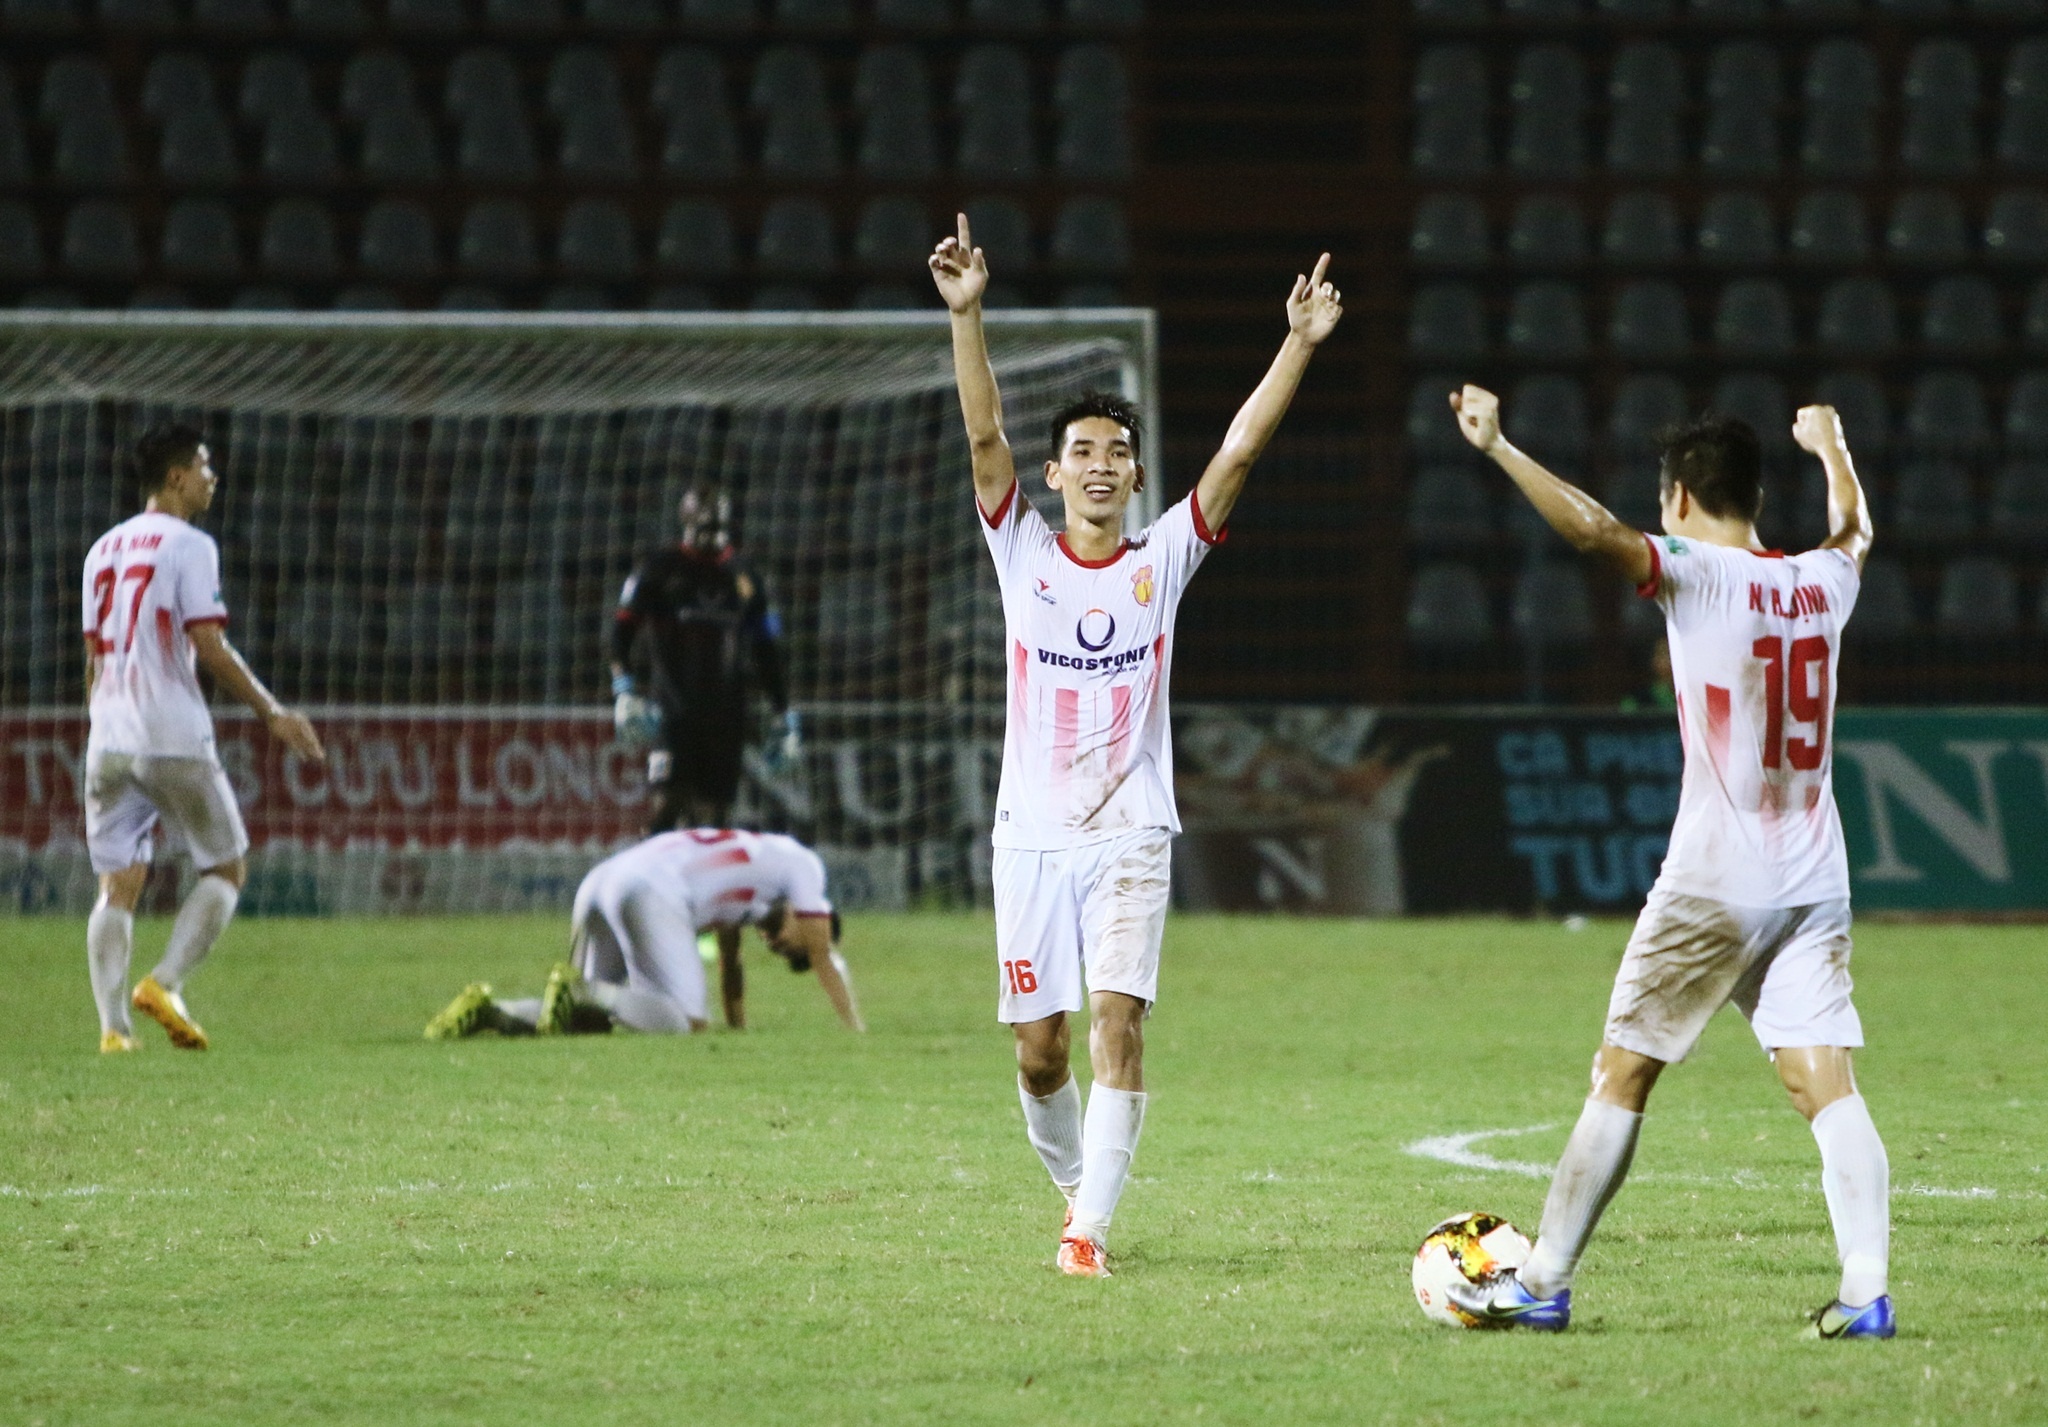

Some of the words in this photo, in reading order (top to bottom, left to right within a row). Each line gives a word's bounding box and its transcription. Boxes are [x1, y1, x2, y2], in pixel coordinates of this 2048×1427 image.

[93, 564, 155, 655] 27
[1752, 635, 1830, 770] 19
[456, 738, 648, 807] LONG
[1003, 959, 1038, 995] 16
